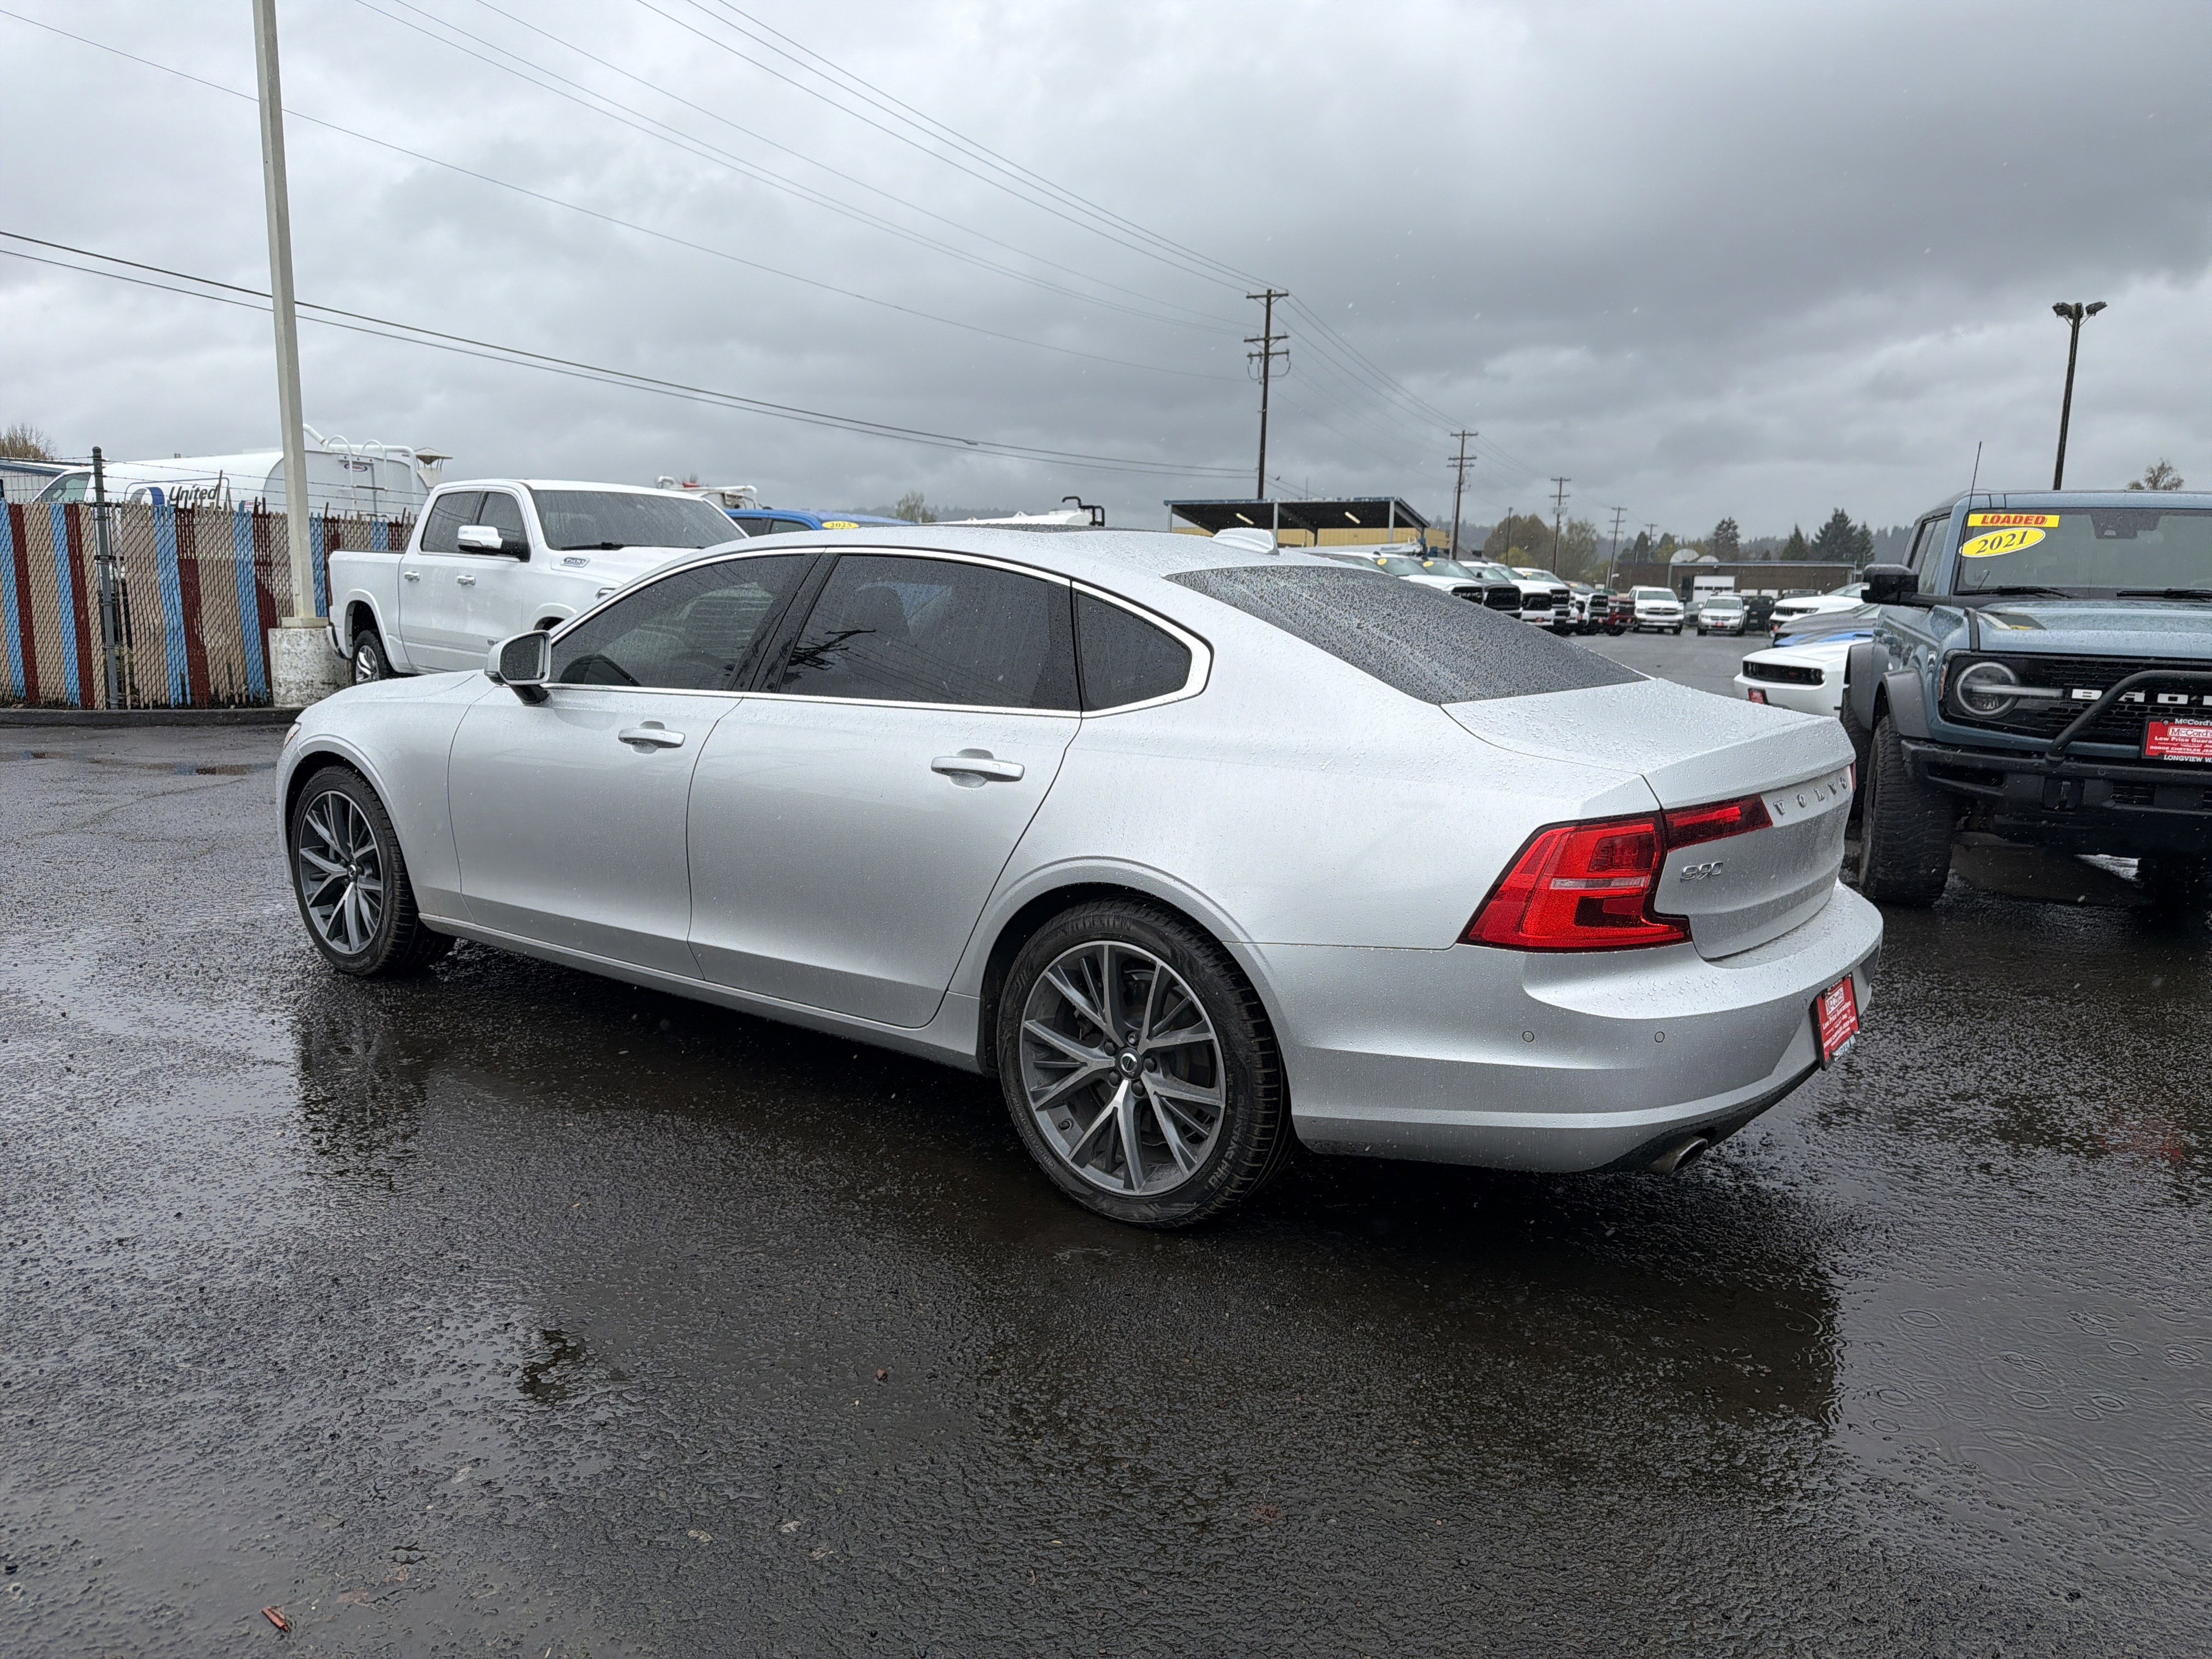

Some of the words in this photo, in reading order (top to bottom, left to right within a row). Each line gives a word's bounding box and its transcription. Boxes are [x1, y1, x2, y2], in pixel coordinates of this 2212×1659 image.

[169, 484, 221, 501] United
[1981, 515, 2047, 526] LOADED
[1975, 530, 2028, 555] 2021
[1773, 777, 1847, 816] VOLVO
[1680, 861, 1724, 882] S90
